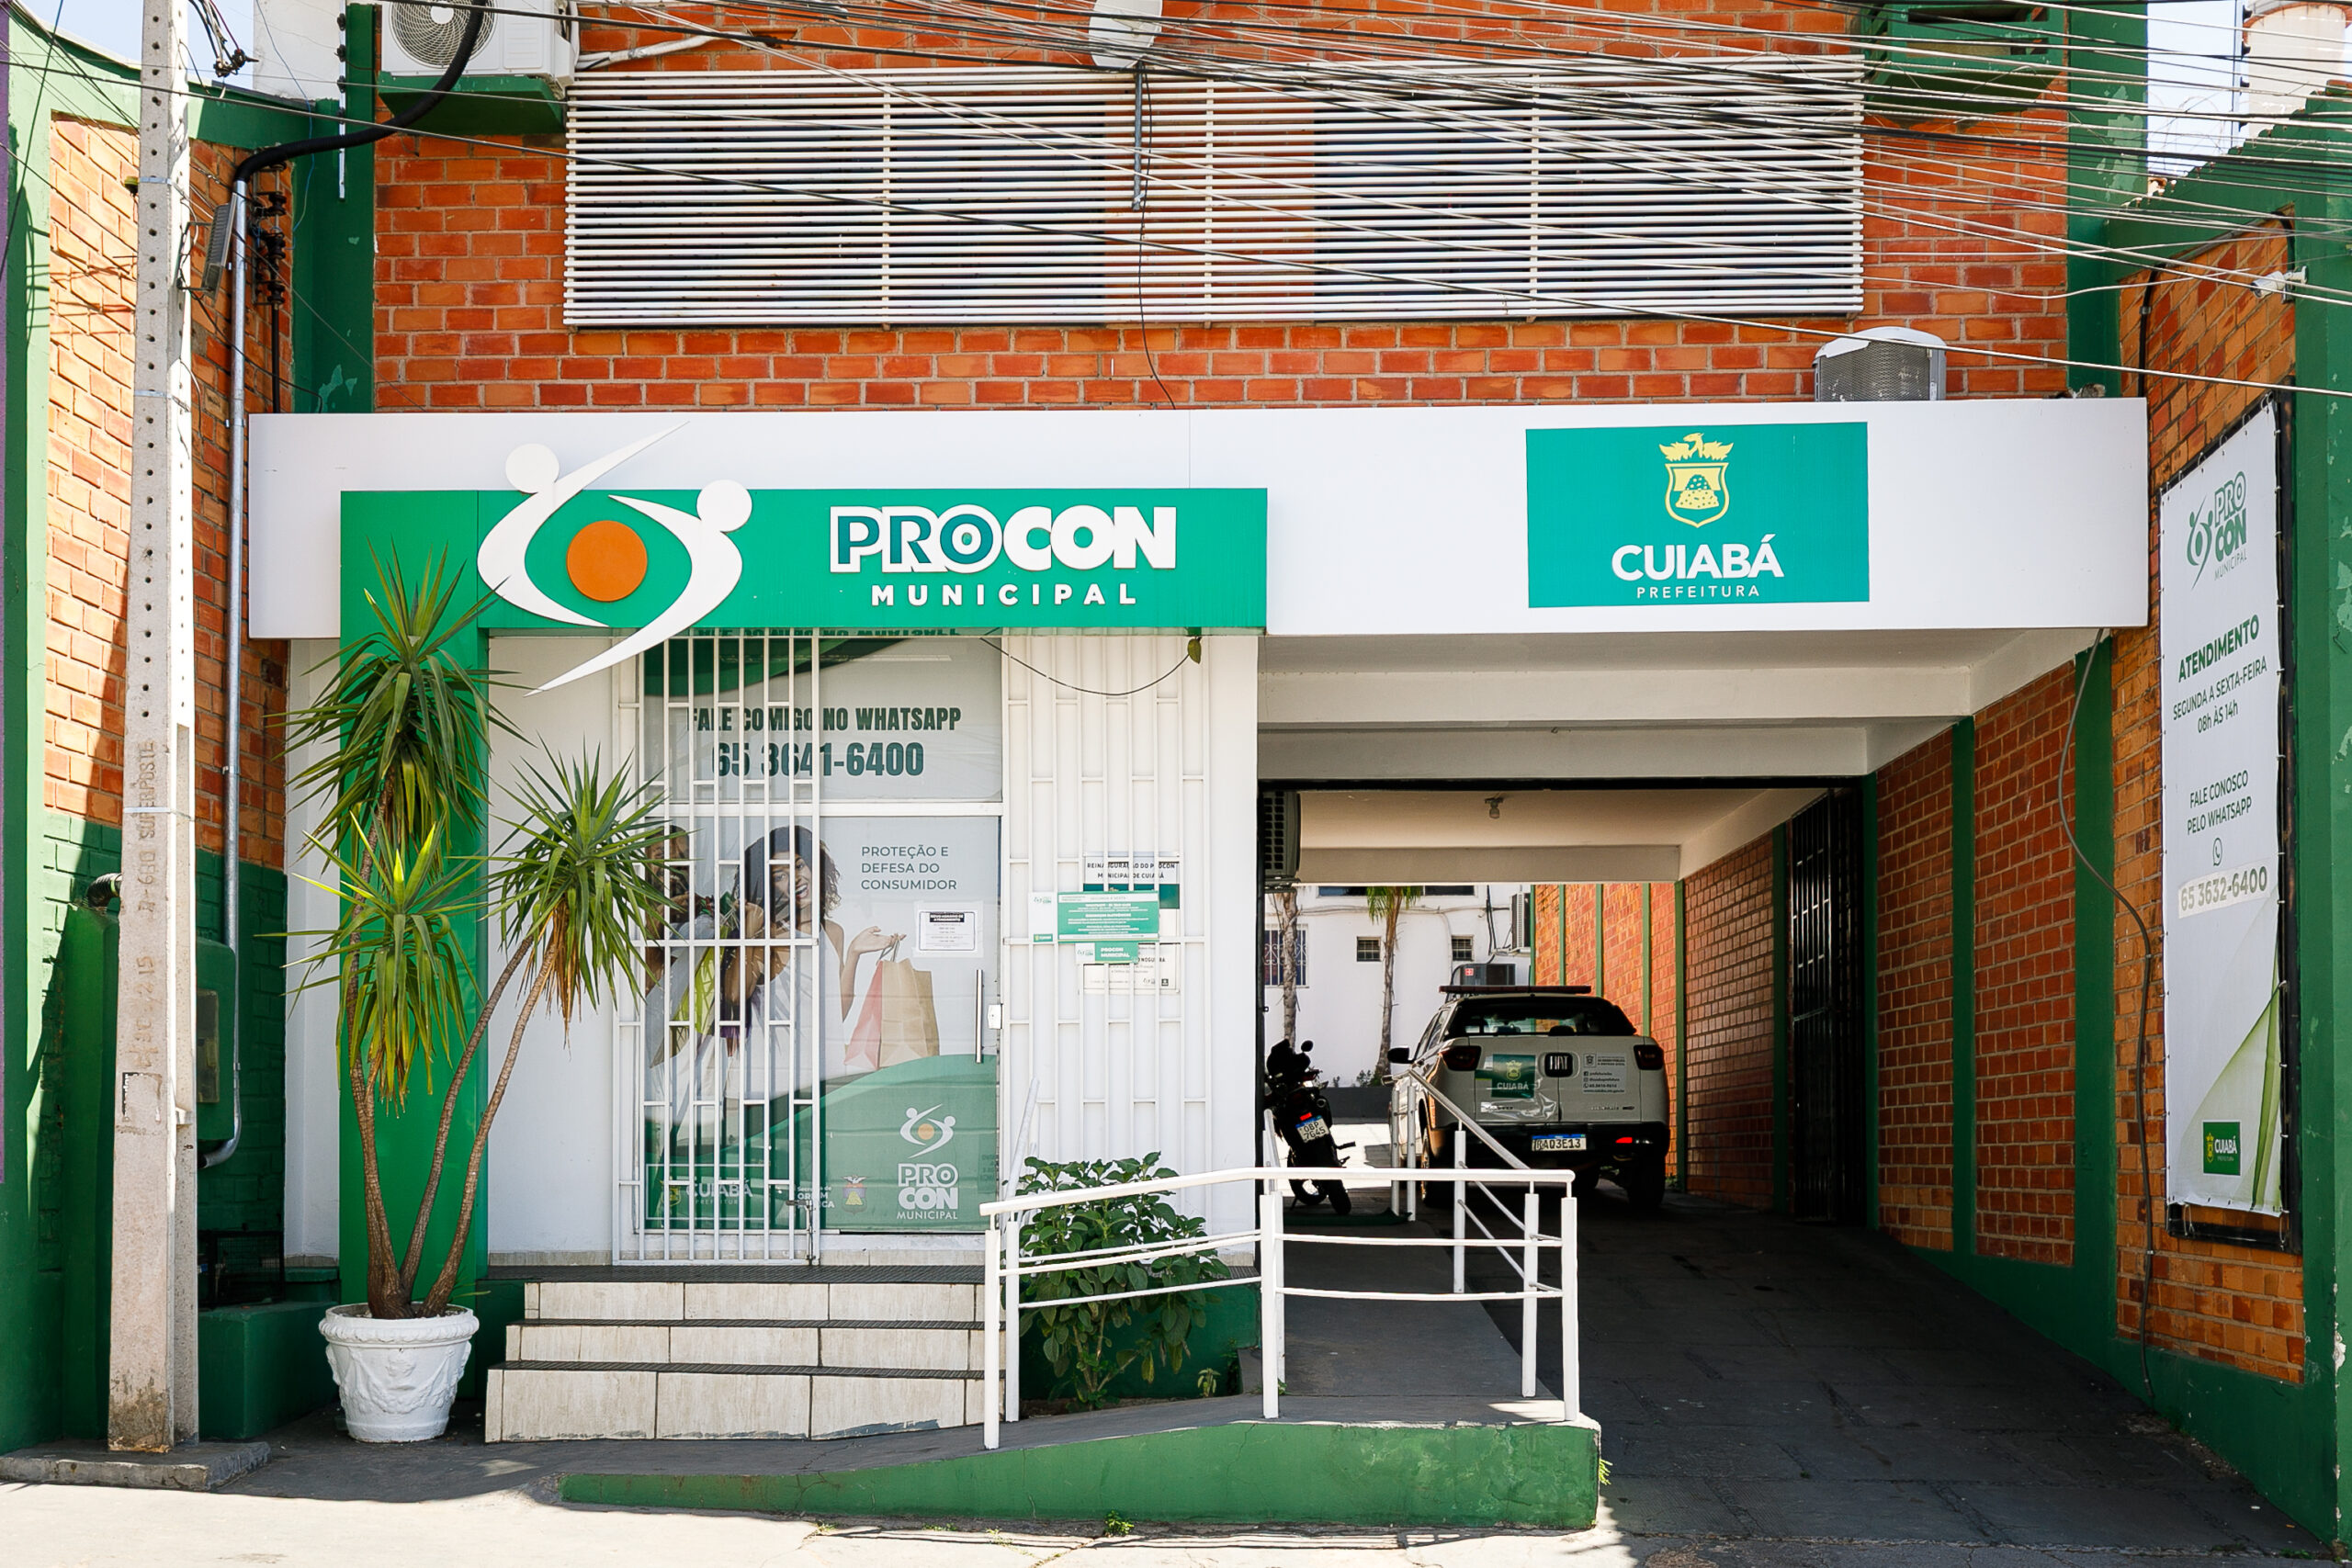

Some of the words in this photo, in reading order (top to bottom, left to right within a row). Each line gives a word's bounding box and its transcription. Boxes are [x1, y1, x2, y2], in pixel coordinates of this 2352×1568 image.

[2214, 471, 2246, 528] PRO
[830, 504, 1177, 574] PROCON
[2215, 508, 2246, 562] CON
[1611, 534, 1784, 581] CUIABÁ
[2214, 548, 2247, 581] MUNICIPAL
[871, 583, 1136, 606] MUNICIPAL
[1636, 584, 1759, 599] PREFEITURA
[2178, 614, 2259, 682] ATENDIMENTO
[2173, 689, 2208, 720] SEGUNDA
[2209, 685, 2215, 702] A
[2216, 655, 2267, 698] SEXTA-FEIRA
[741, 707, 816, 731] COMIGO
[822, 707, 849, 731] NO
[855, 707, 962, 731] WHATSAPP
[2198, 713, 2212, 733] 08h
[2213, 705, 2223, 726] ÀS
[2224, 699, 2239, 720] 14h
[711, 741, 751, 777] 65
[761, 741, 924, 777] 3641-6400
[2189, 786, 2208, 808] FALE
[2209, 770, 2249, 800] CONOSCO
[2187, 814, 2206, 835] PELO
[2208, 795, 2252, 827] WHATSAPP
[862, 844, 937, 860] PROTEÇÃO
[941, 846, 949, 857] E
[862, 863, 915, 874] DEFESA
[919, 863, 940, 874] DO
[861, 879, 957, 890] CONSUMIDOR
[2180, 886, 2195, 911] 65
[2198, 865, 2267, 907] 3632-6400
[1497, 1081, 1530, 1090] CUIABÁ
[2214, 1134, 2238, 1154] CUIABÁ
[898, 1163, 959, 1188] PRO
[898, 1187, 959, 1210] CON
[897, 1212, 958, 1220] MUNICIPAL
